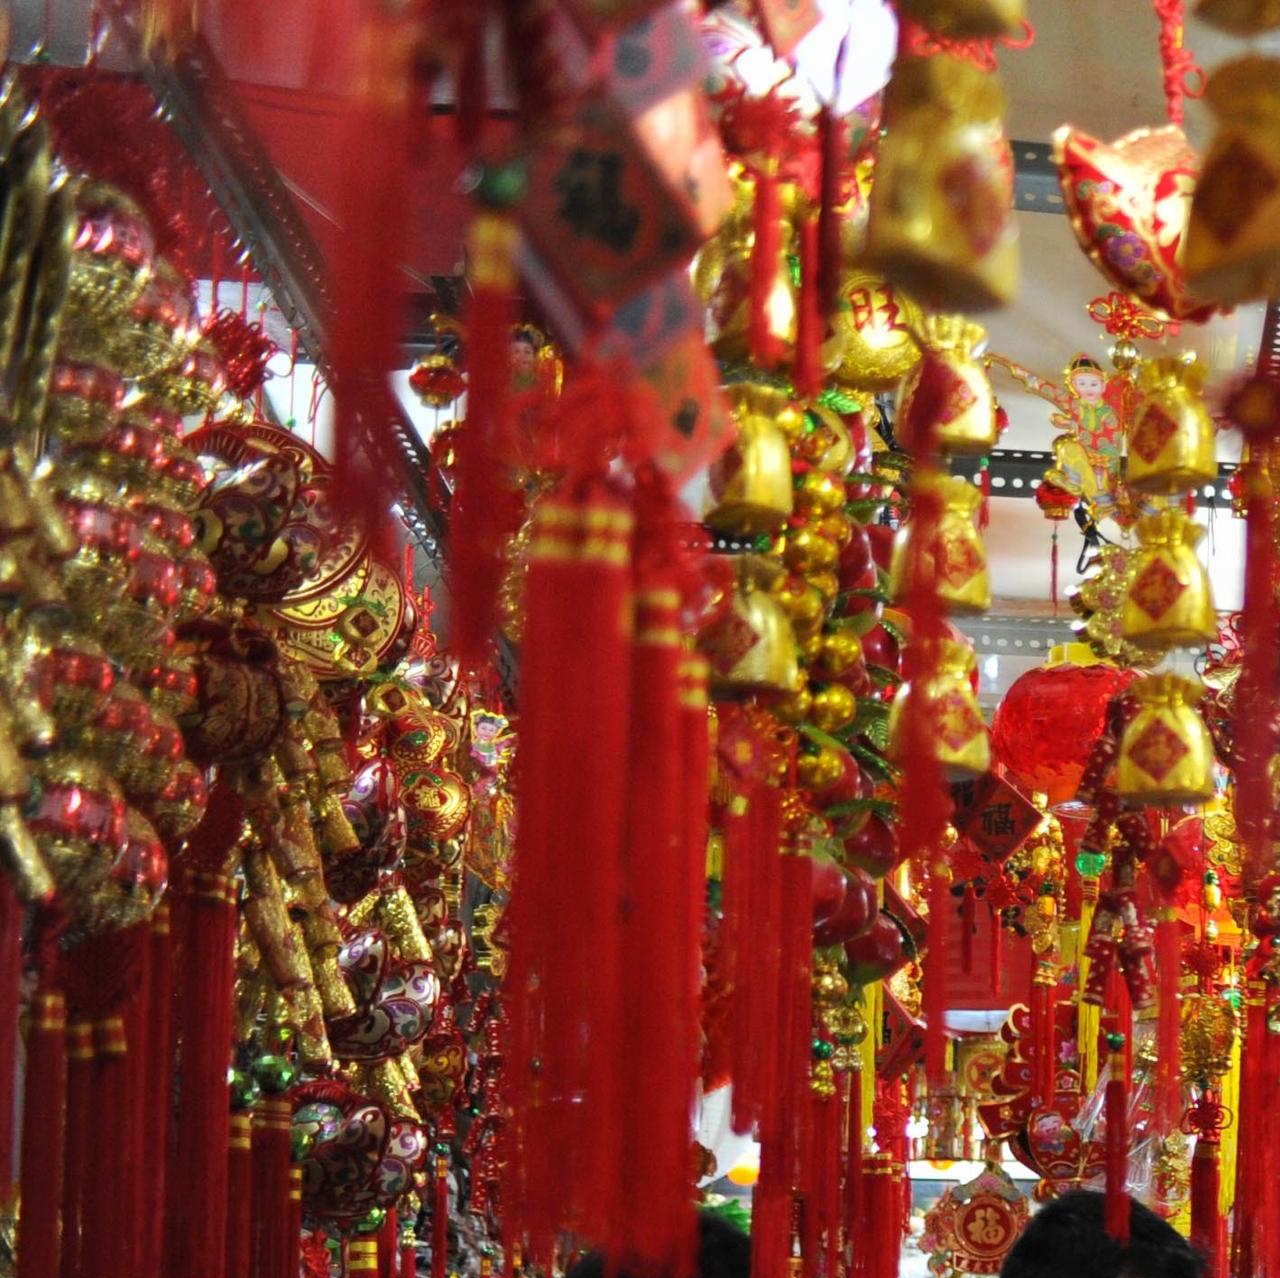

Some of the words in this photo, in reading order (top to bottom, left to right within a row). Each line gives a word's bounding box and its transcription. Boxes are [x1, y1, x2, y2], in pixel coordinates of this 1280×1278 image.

[848, 286, 908, 331] 旺
[981, 802, 1016, 836] 福
[967, 1207, 1006, 1245] 福
